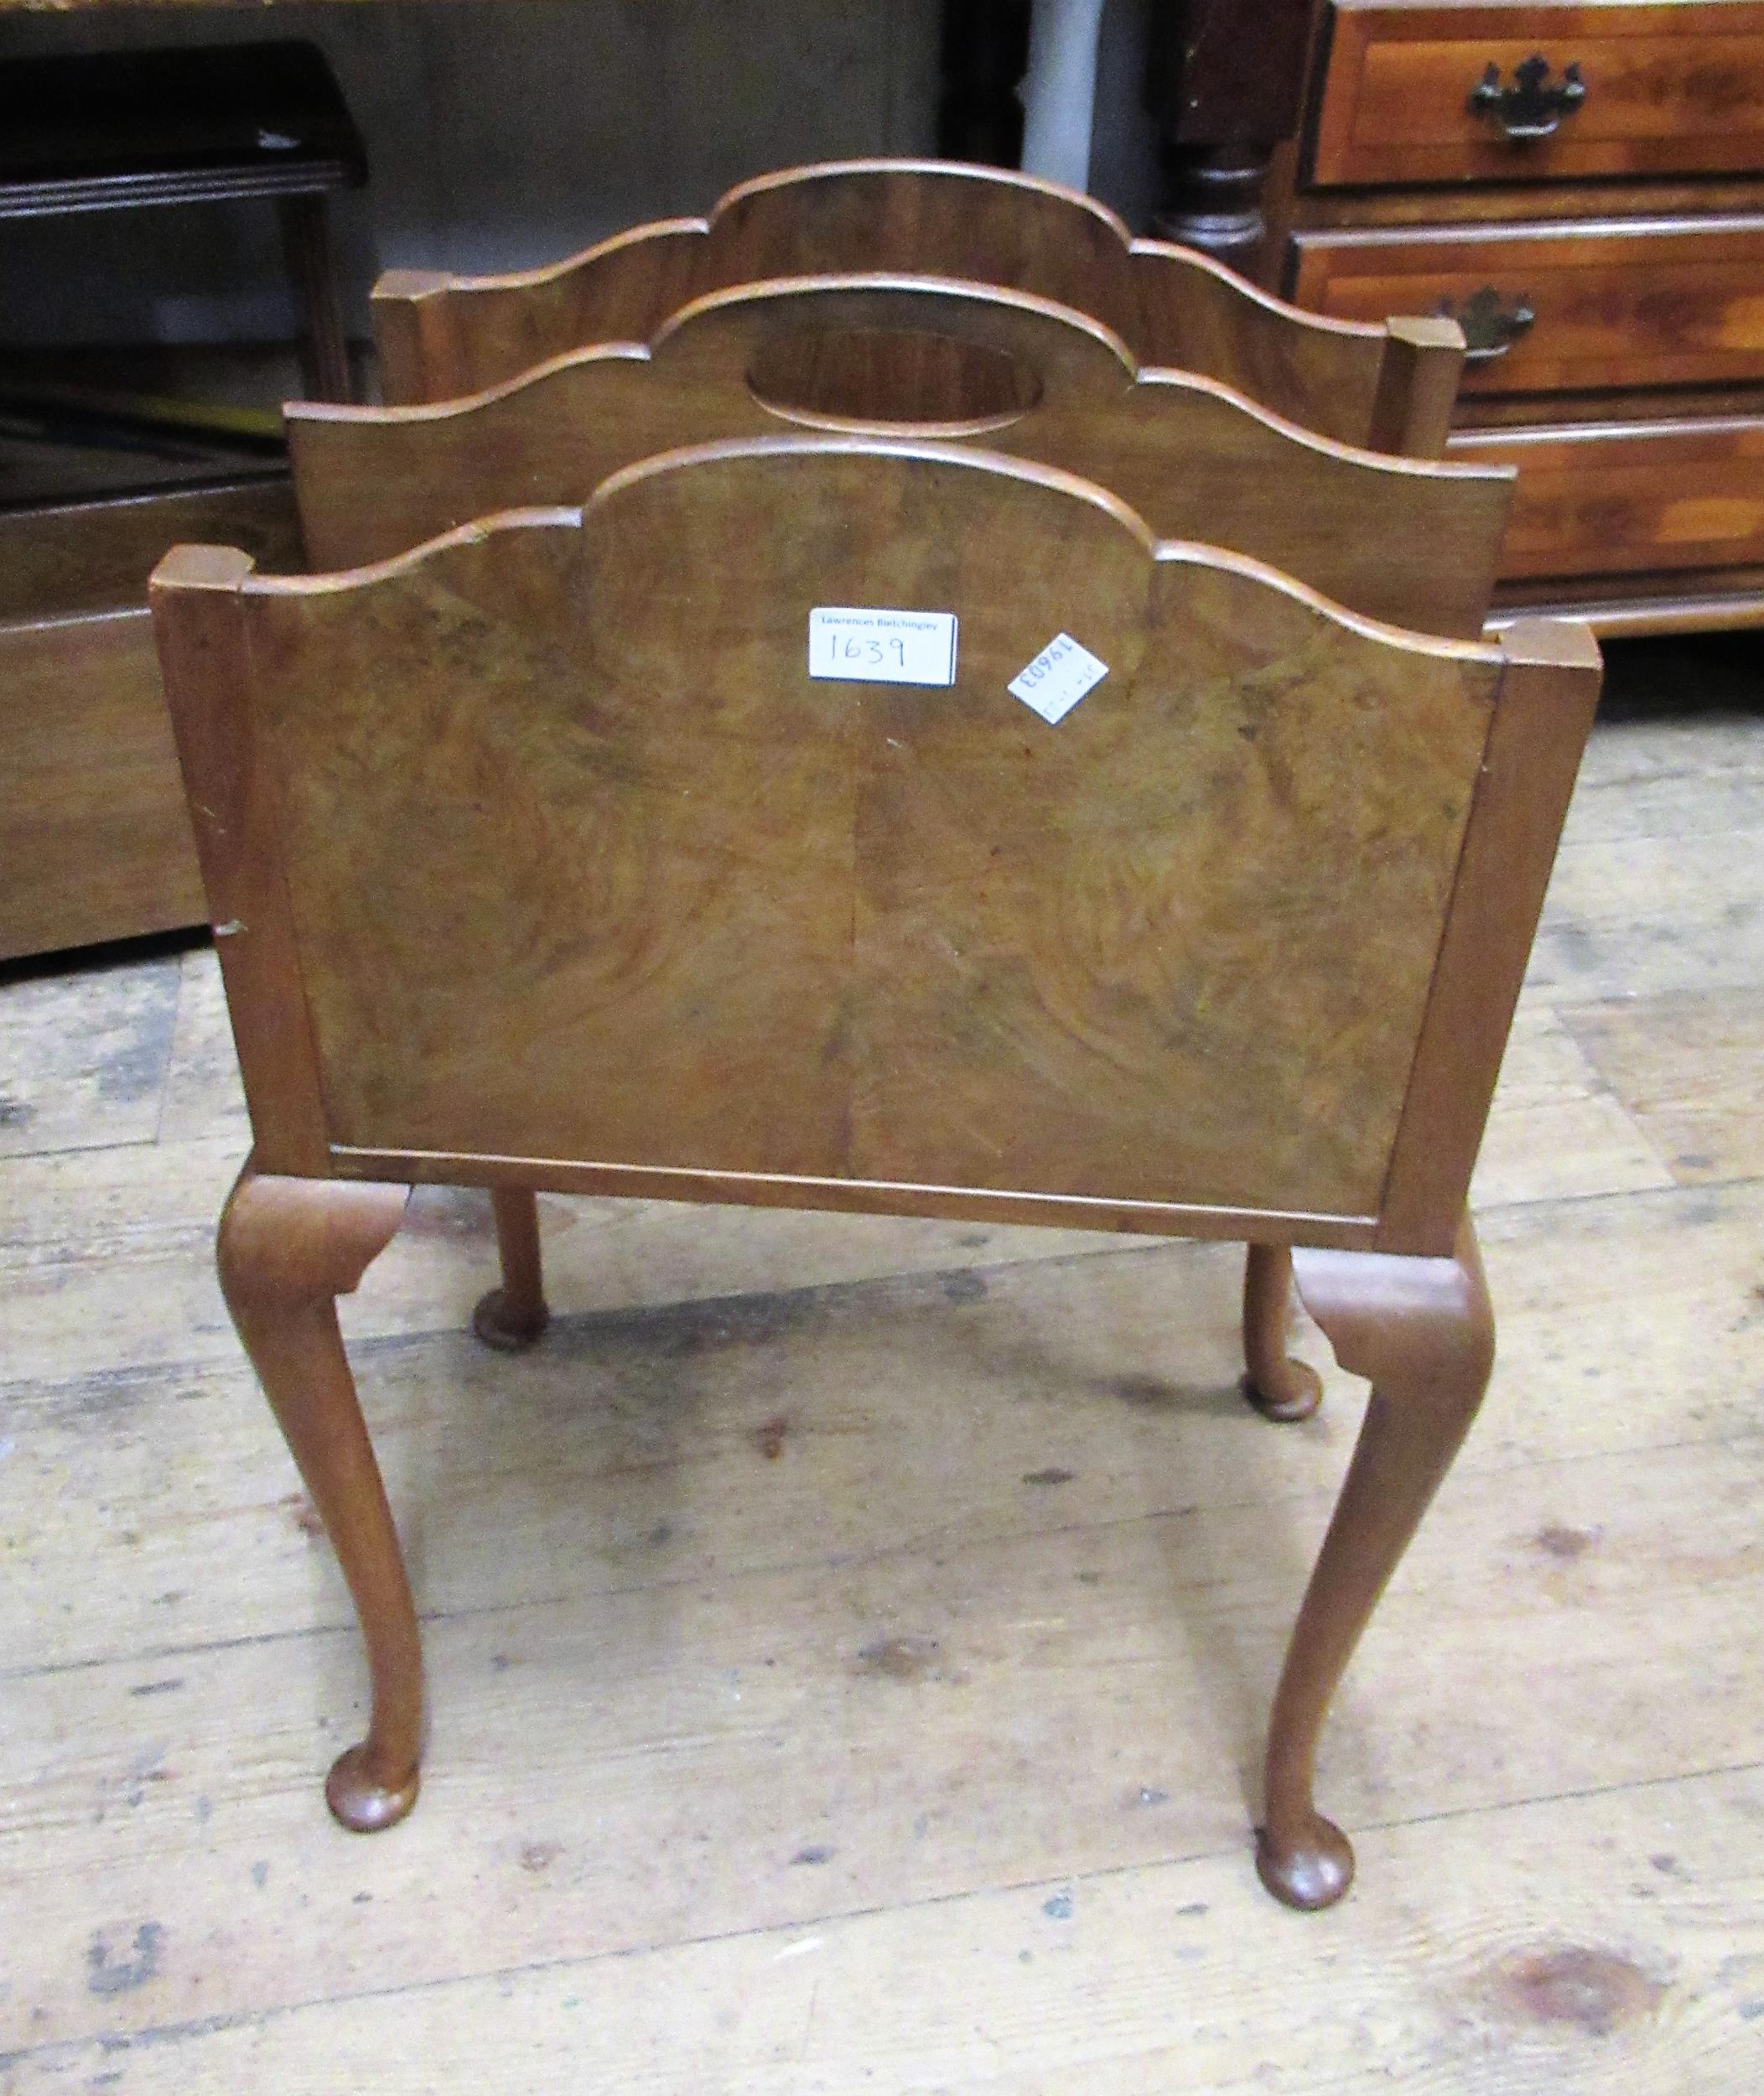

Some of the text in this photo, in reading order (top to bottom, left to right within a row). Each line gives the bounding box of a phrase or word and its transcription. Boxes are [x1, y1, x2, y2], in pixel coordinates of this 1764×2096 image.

[822, 616, 874, 626] Lawrences
[831, 634, 905, 667] 1639
[1019, 639, 1072, 687] 19603
